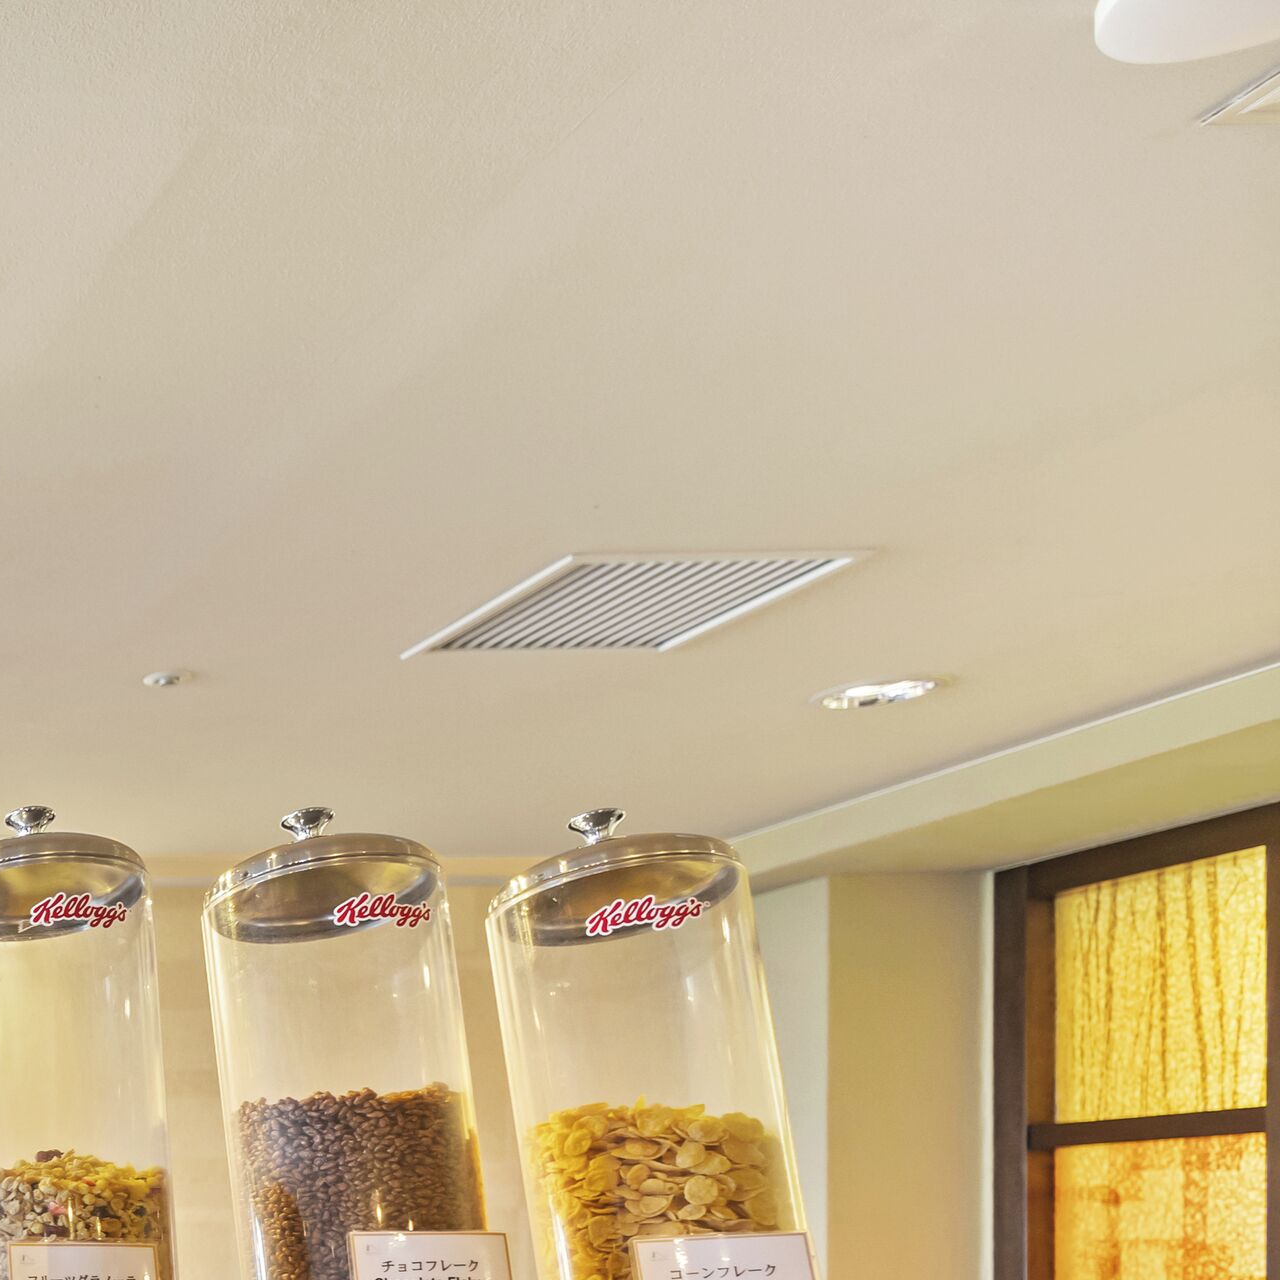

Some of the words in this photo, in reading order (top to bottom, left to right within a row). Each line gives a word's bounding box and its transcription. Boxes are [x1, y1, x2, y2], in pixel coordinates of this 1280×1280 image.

[31, 893, 127, 928] Kellogg's
[335, 893, 431, 928] Kellogg's
[587, 896, 702, 934] Kellogg's
[381, 1259, 479, 1273] チョコフレーク
[670, 1263, 776, 1280] コーンフレーク
